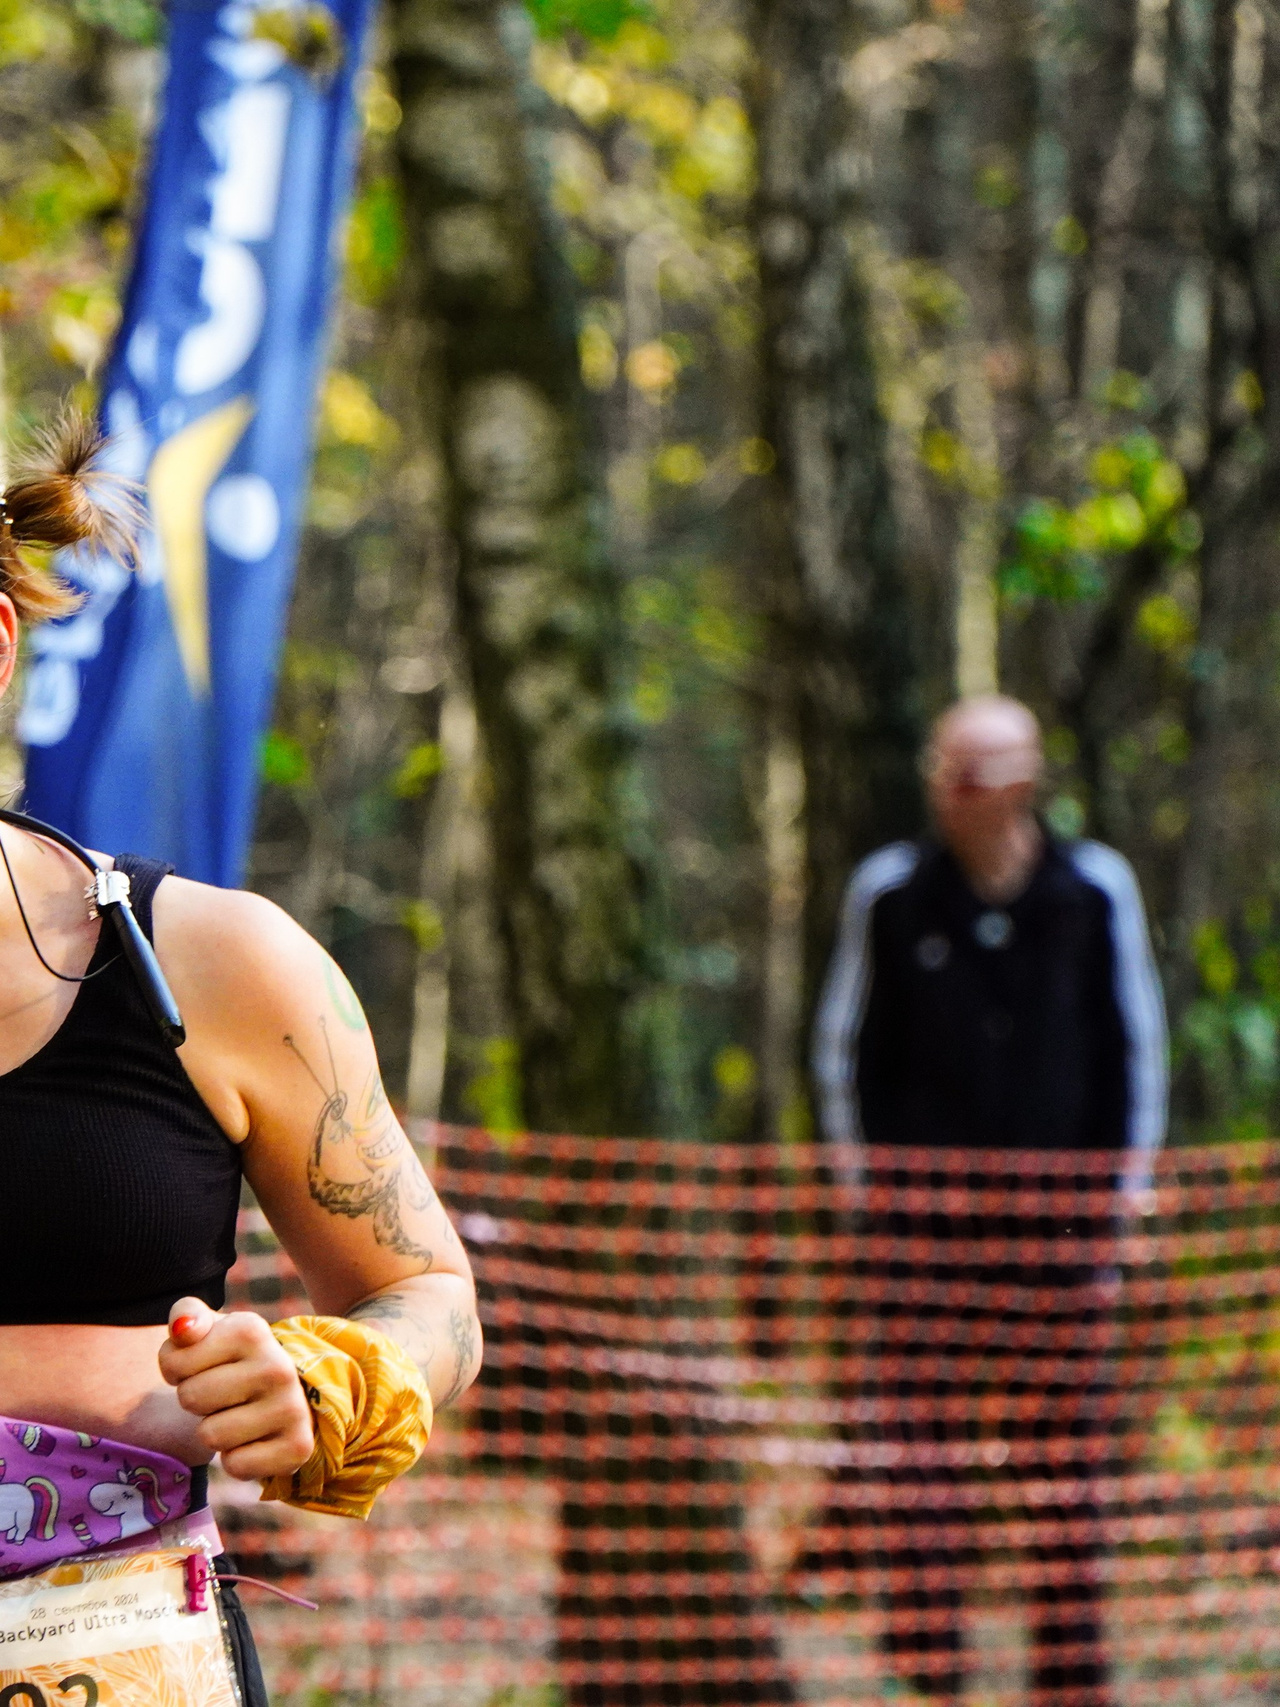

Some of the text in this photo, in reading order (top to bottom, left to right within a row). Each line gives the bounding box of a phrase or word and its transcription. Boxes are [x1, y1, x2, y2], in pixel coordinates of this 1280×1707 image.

[30, 1606, 47, 1620] 28
[113, 1593, 140, 1607] 2024
[83, 1613, 127, 1631] Ultra
